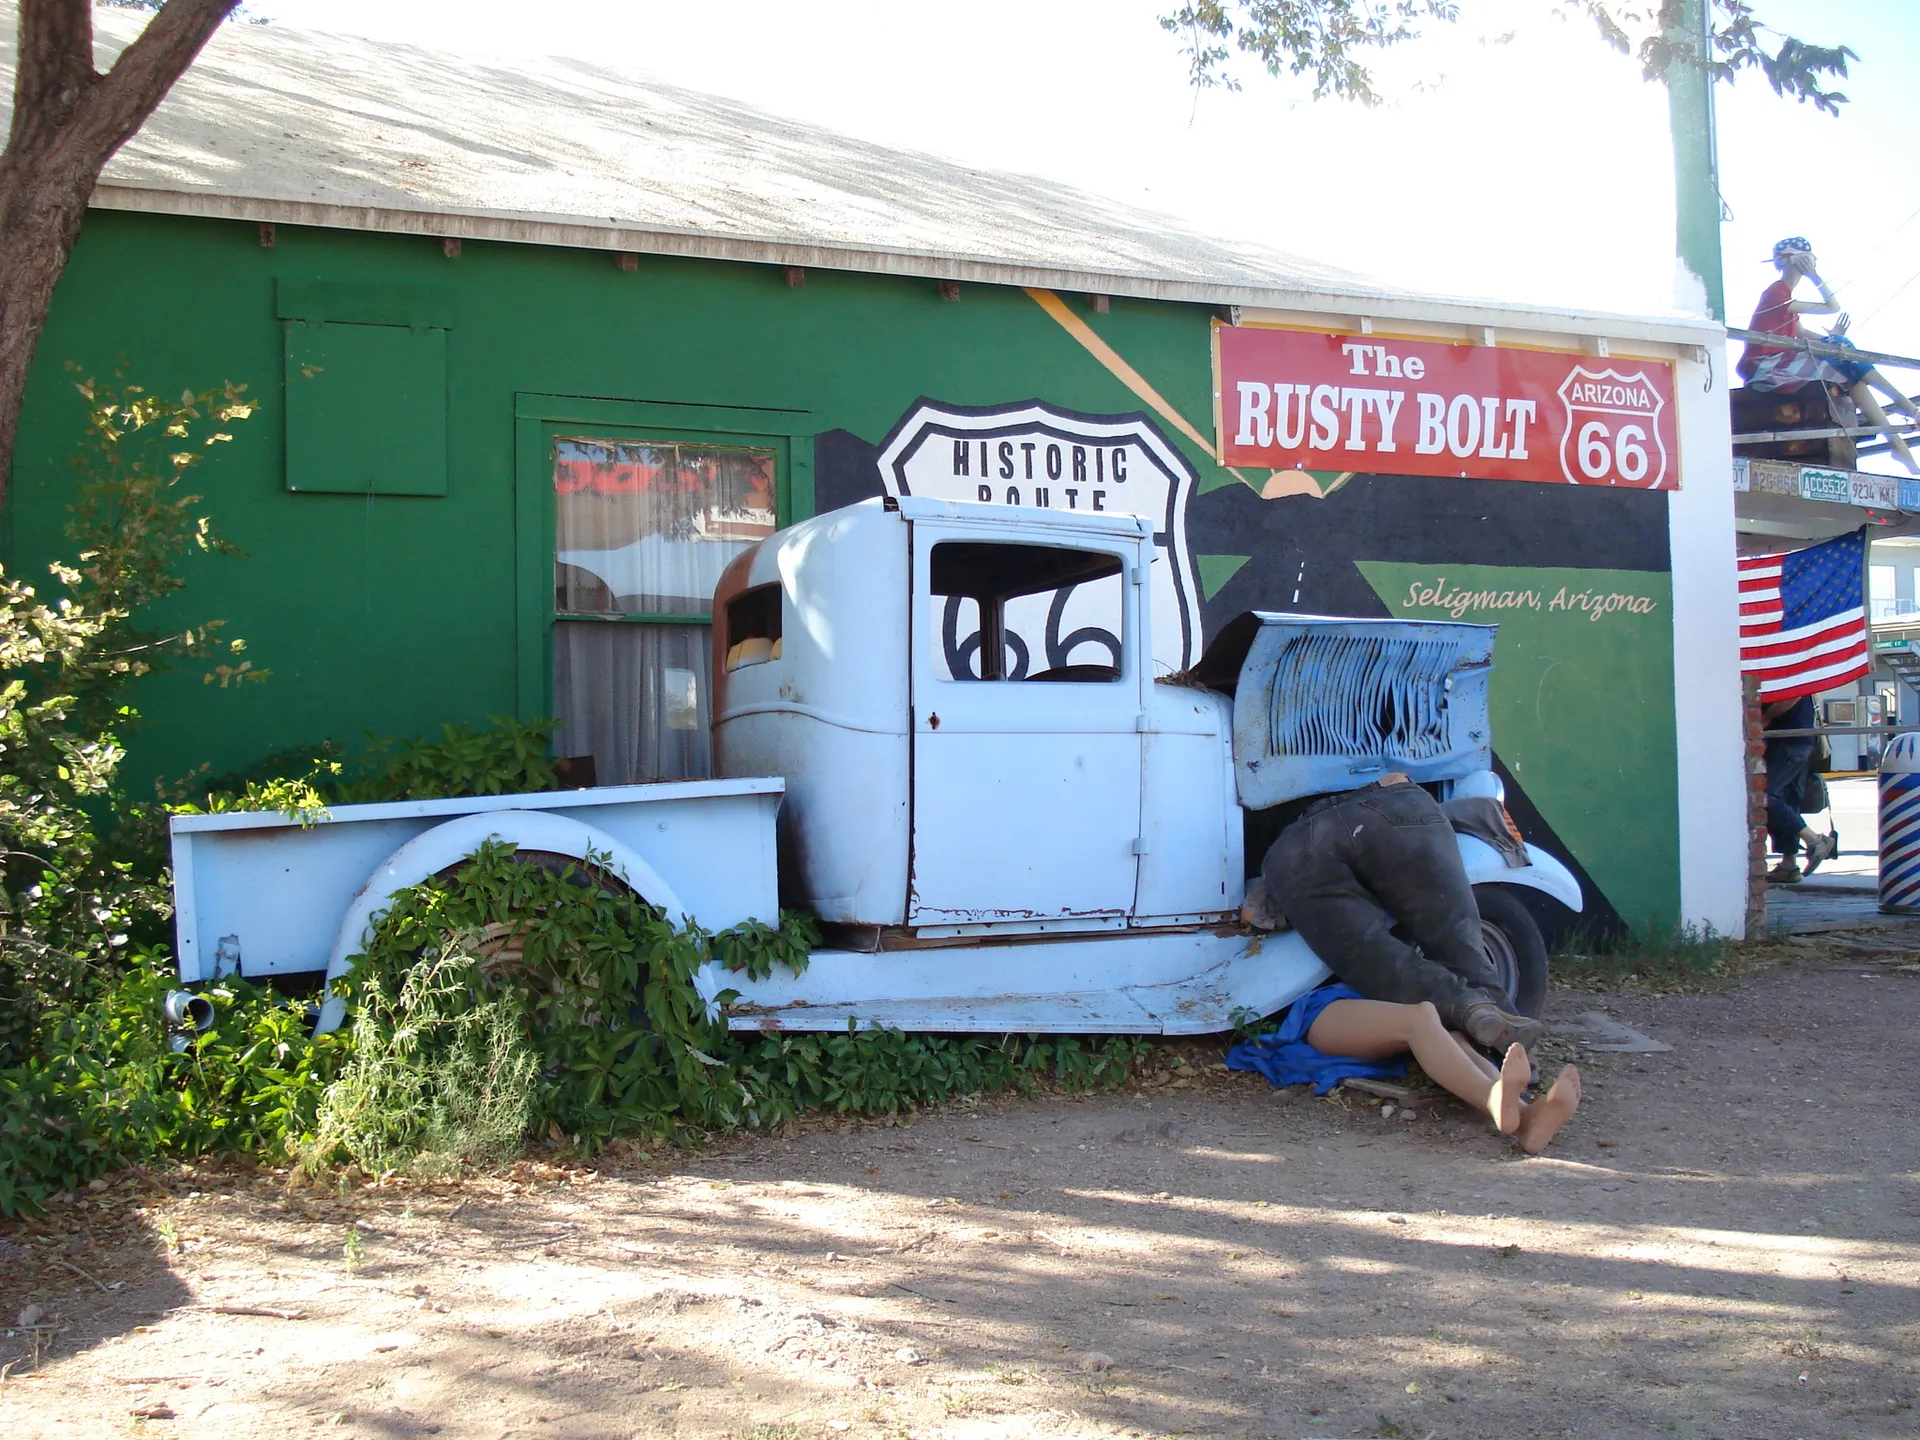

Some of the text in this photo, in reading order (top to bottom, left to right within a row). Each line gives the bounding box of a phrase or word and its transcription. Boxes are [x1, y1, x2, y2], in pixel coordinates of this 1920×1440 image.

[1342, 343, 1425, 380] The
[1571, 382, 1651, 409] ARIZONA
[1234, 381, 1537, 460] RUSTY BOLT
[952, 440, 1128, 483] HISTORIC
[1577, 421, 1649, 481] 66
[1804, 475, 1847, 495] ACC6532
[1402, 577, 1658, 621] Seligman, Arizona
[942, 586, 1122, 682] 66
